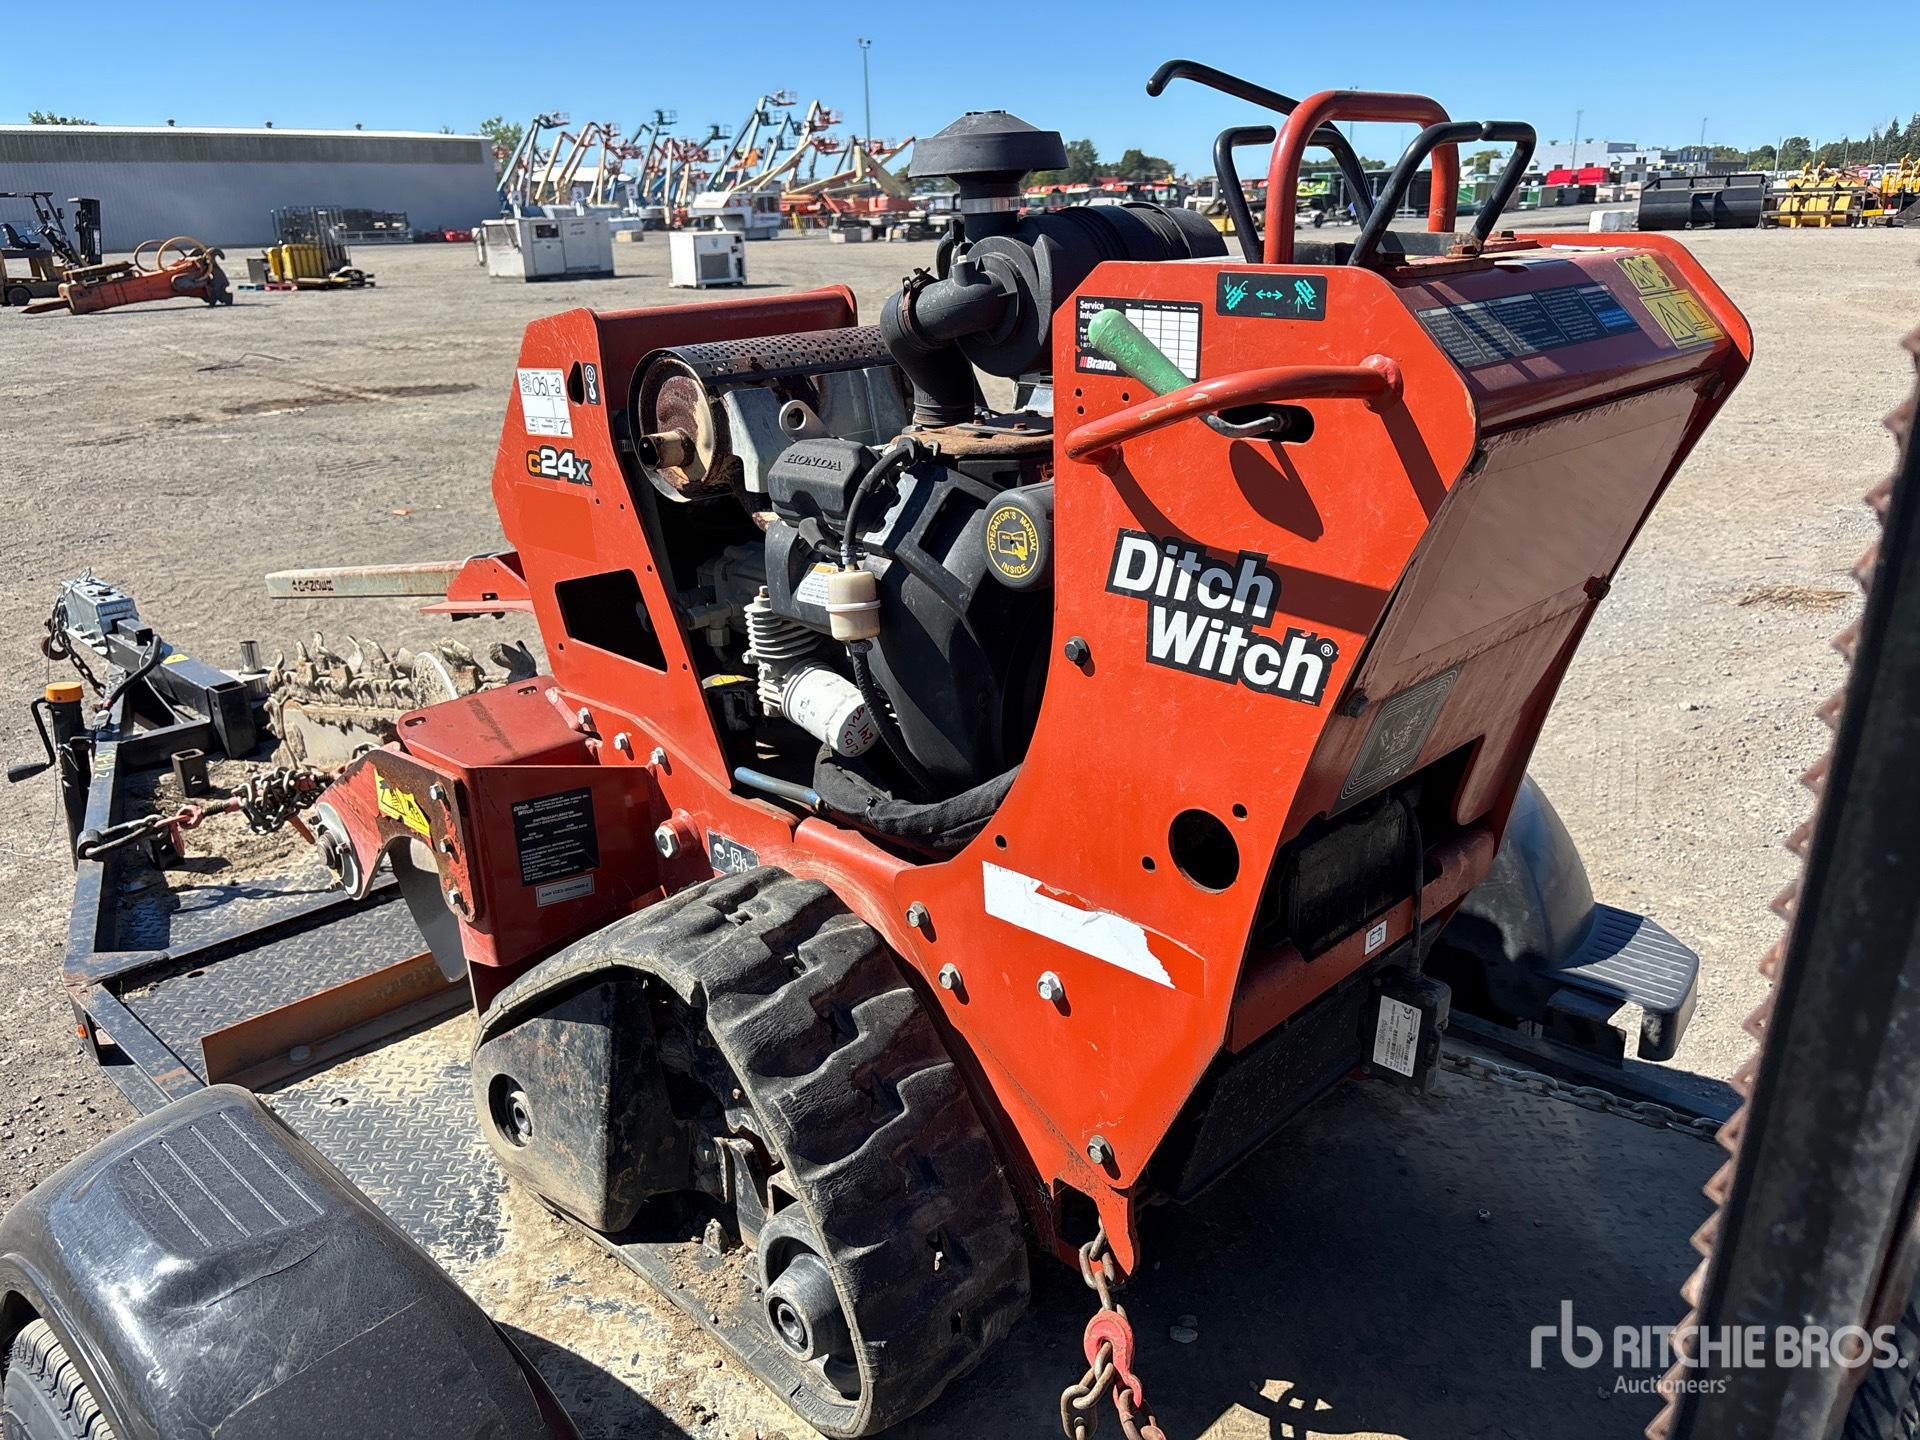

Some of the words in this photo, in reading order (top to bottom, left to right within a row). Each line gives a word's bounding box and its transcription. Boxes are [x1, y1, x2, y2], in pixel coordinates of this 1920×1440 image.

[1080, 300, 1105, 311] Service
[1086, 357, 1117, 371] Brand
[784, 453, 841, 471] HONDA
[989, 511, 1017, 551] OPERATOR'S
[1019, 516, 1037, 552] MANUAL
[1001, 561, 1027, 574] INSIDE
[1112, 536, 1274, 619] Ditch
